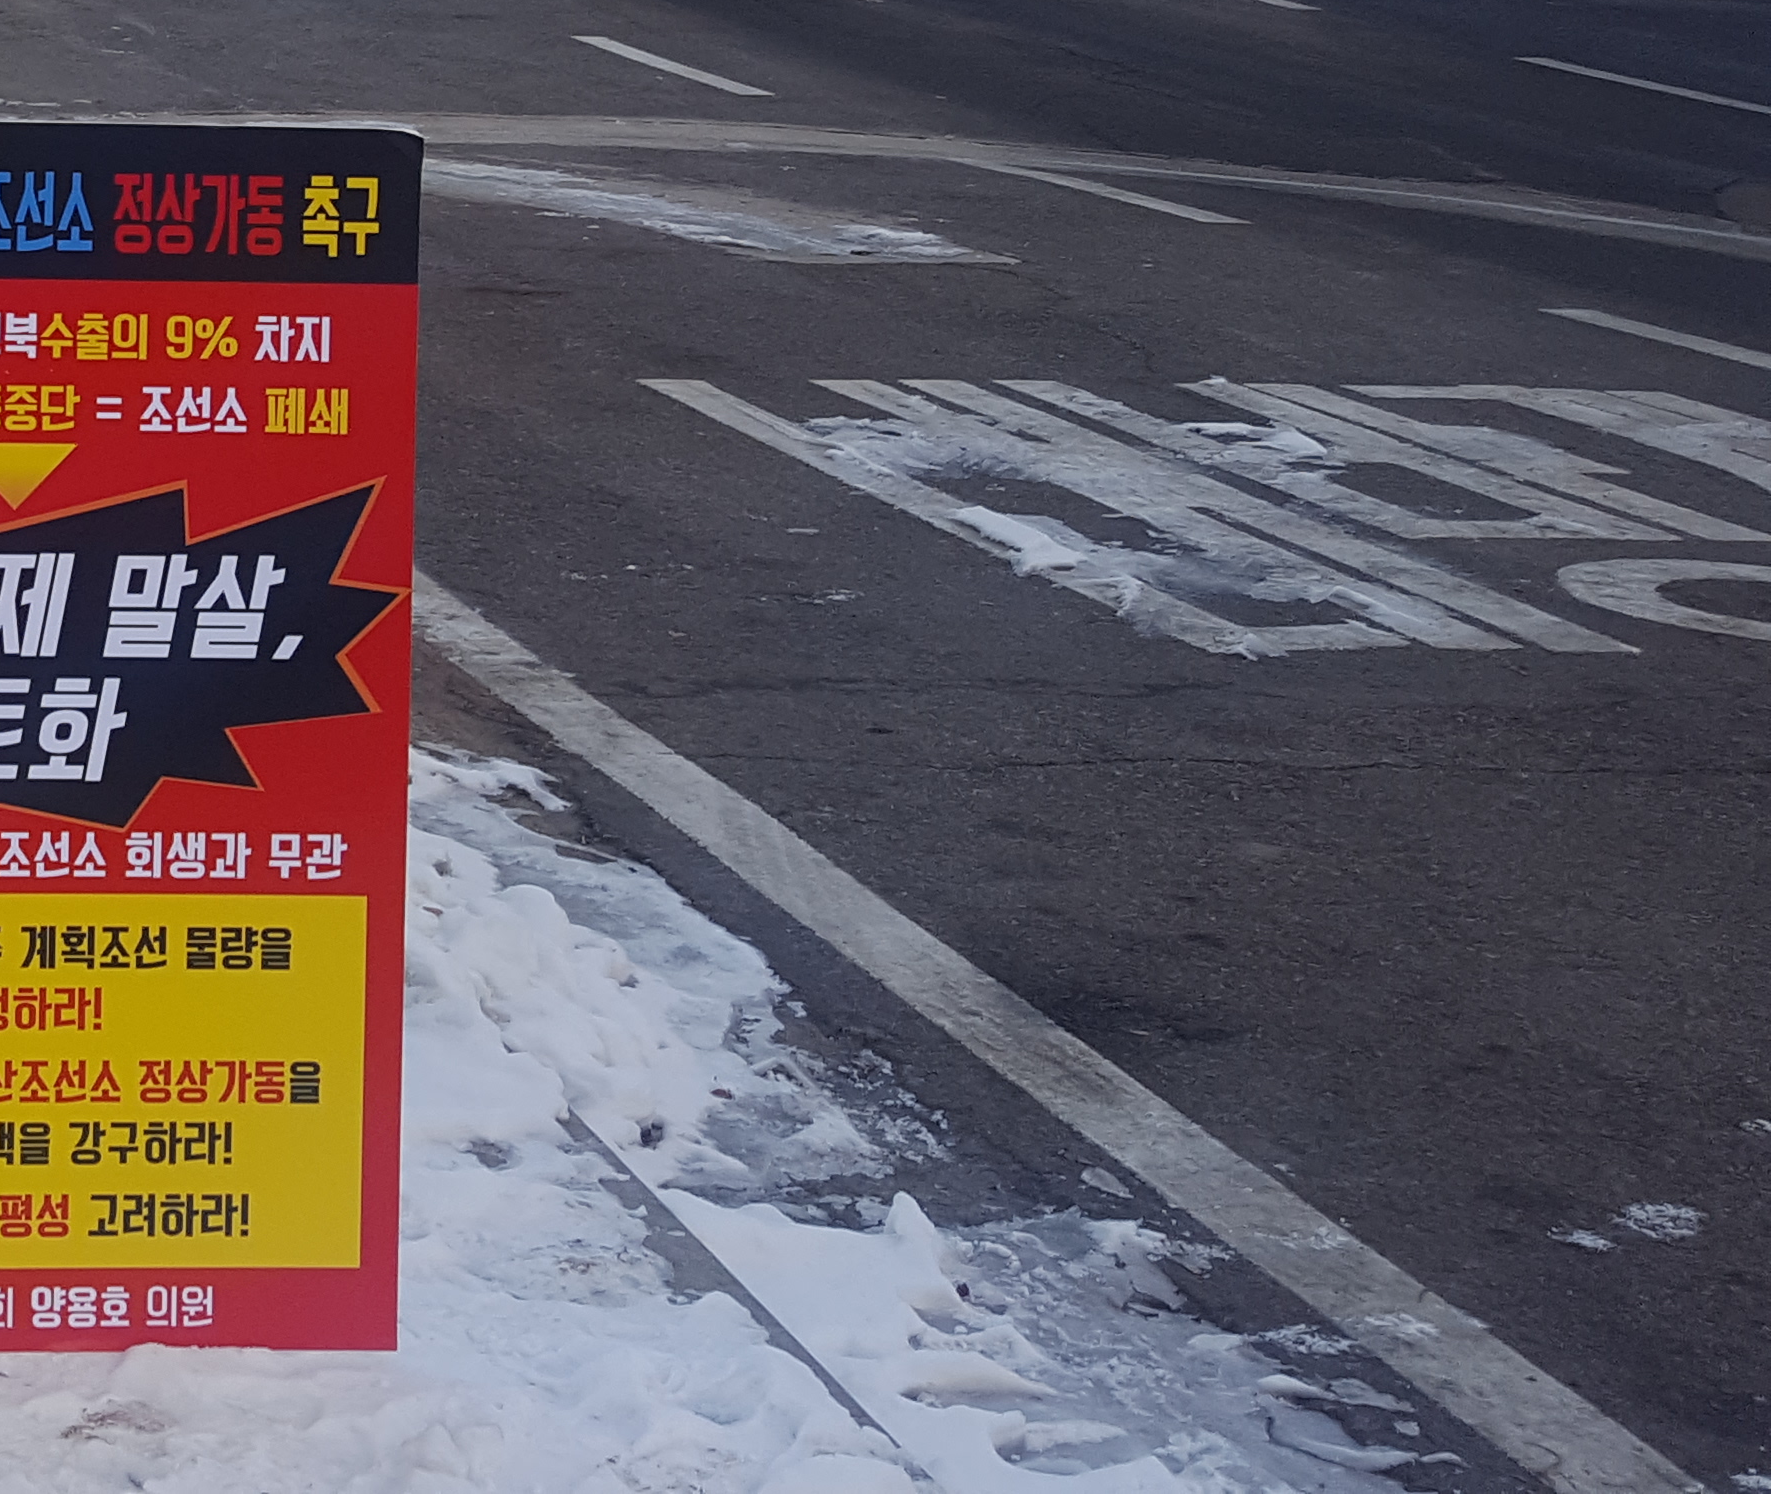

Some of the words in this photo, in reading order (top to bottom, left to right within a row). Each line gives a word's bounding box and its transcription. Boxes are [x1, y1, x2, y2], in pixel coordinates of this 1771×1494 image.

[113, 173, 284, 256] 정상가동
[302, 175, 380, 258] 촉구
[166, 315, 238, 360] 9%
[254, 315, 331, 363] 차지
[139, 386, 247, 433] 조선소
[264, 387, 349, 435] 폐쇄
[102, 553, 304, 660] 말살,
[125, 831, 252, 879] 회생과
[268, 833, 348, 880] 무관
[20, 925, 168, 970] 계획조선
[185, 926, 292, 970] 물량을
[138, 1059, 321, 1105] 정상가동을
[68, 1121, 233, 1165] 강구하라!
[87, 1193, 249, 1238] 고려하라!
[30, 1286, 130, 1328] 양용호
[146, 1285, 213, 1327] 의원
